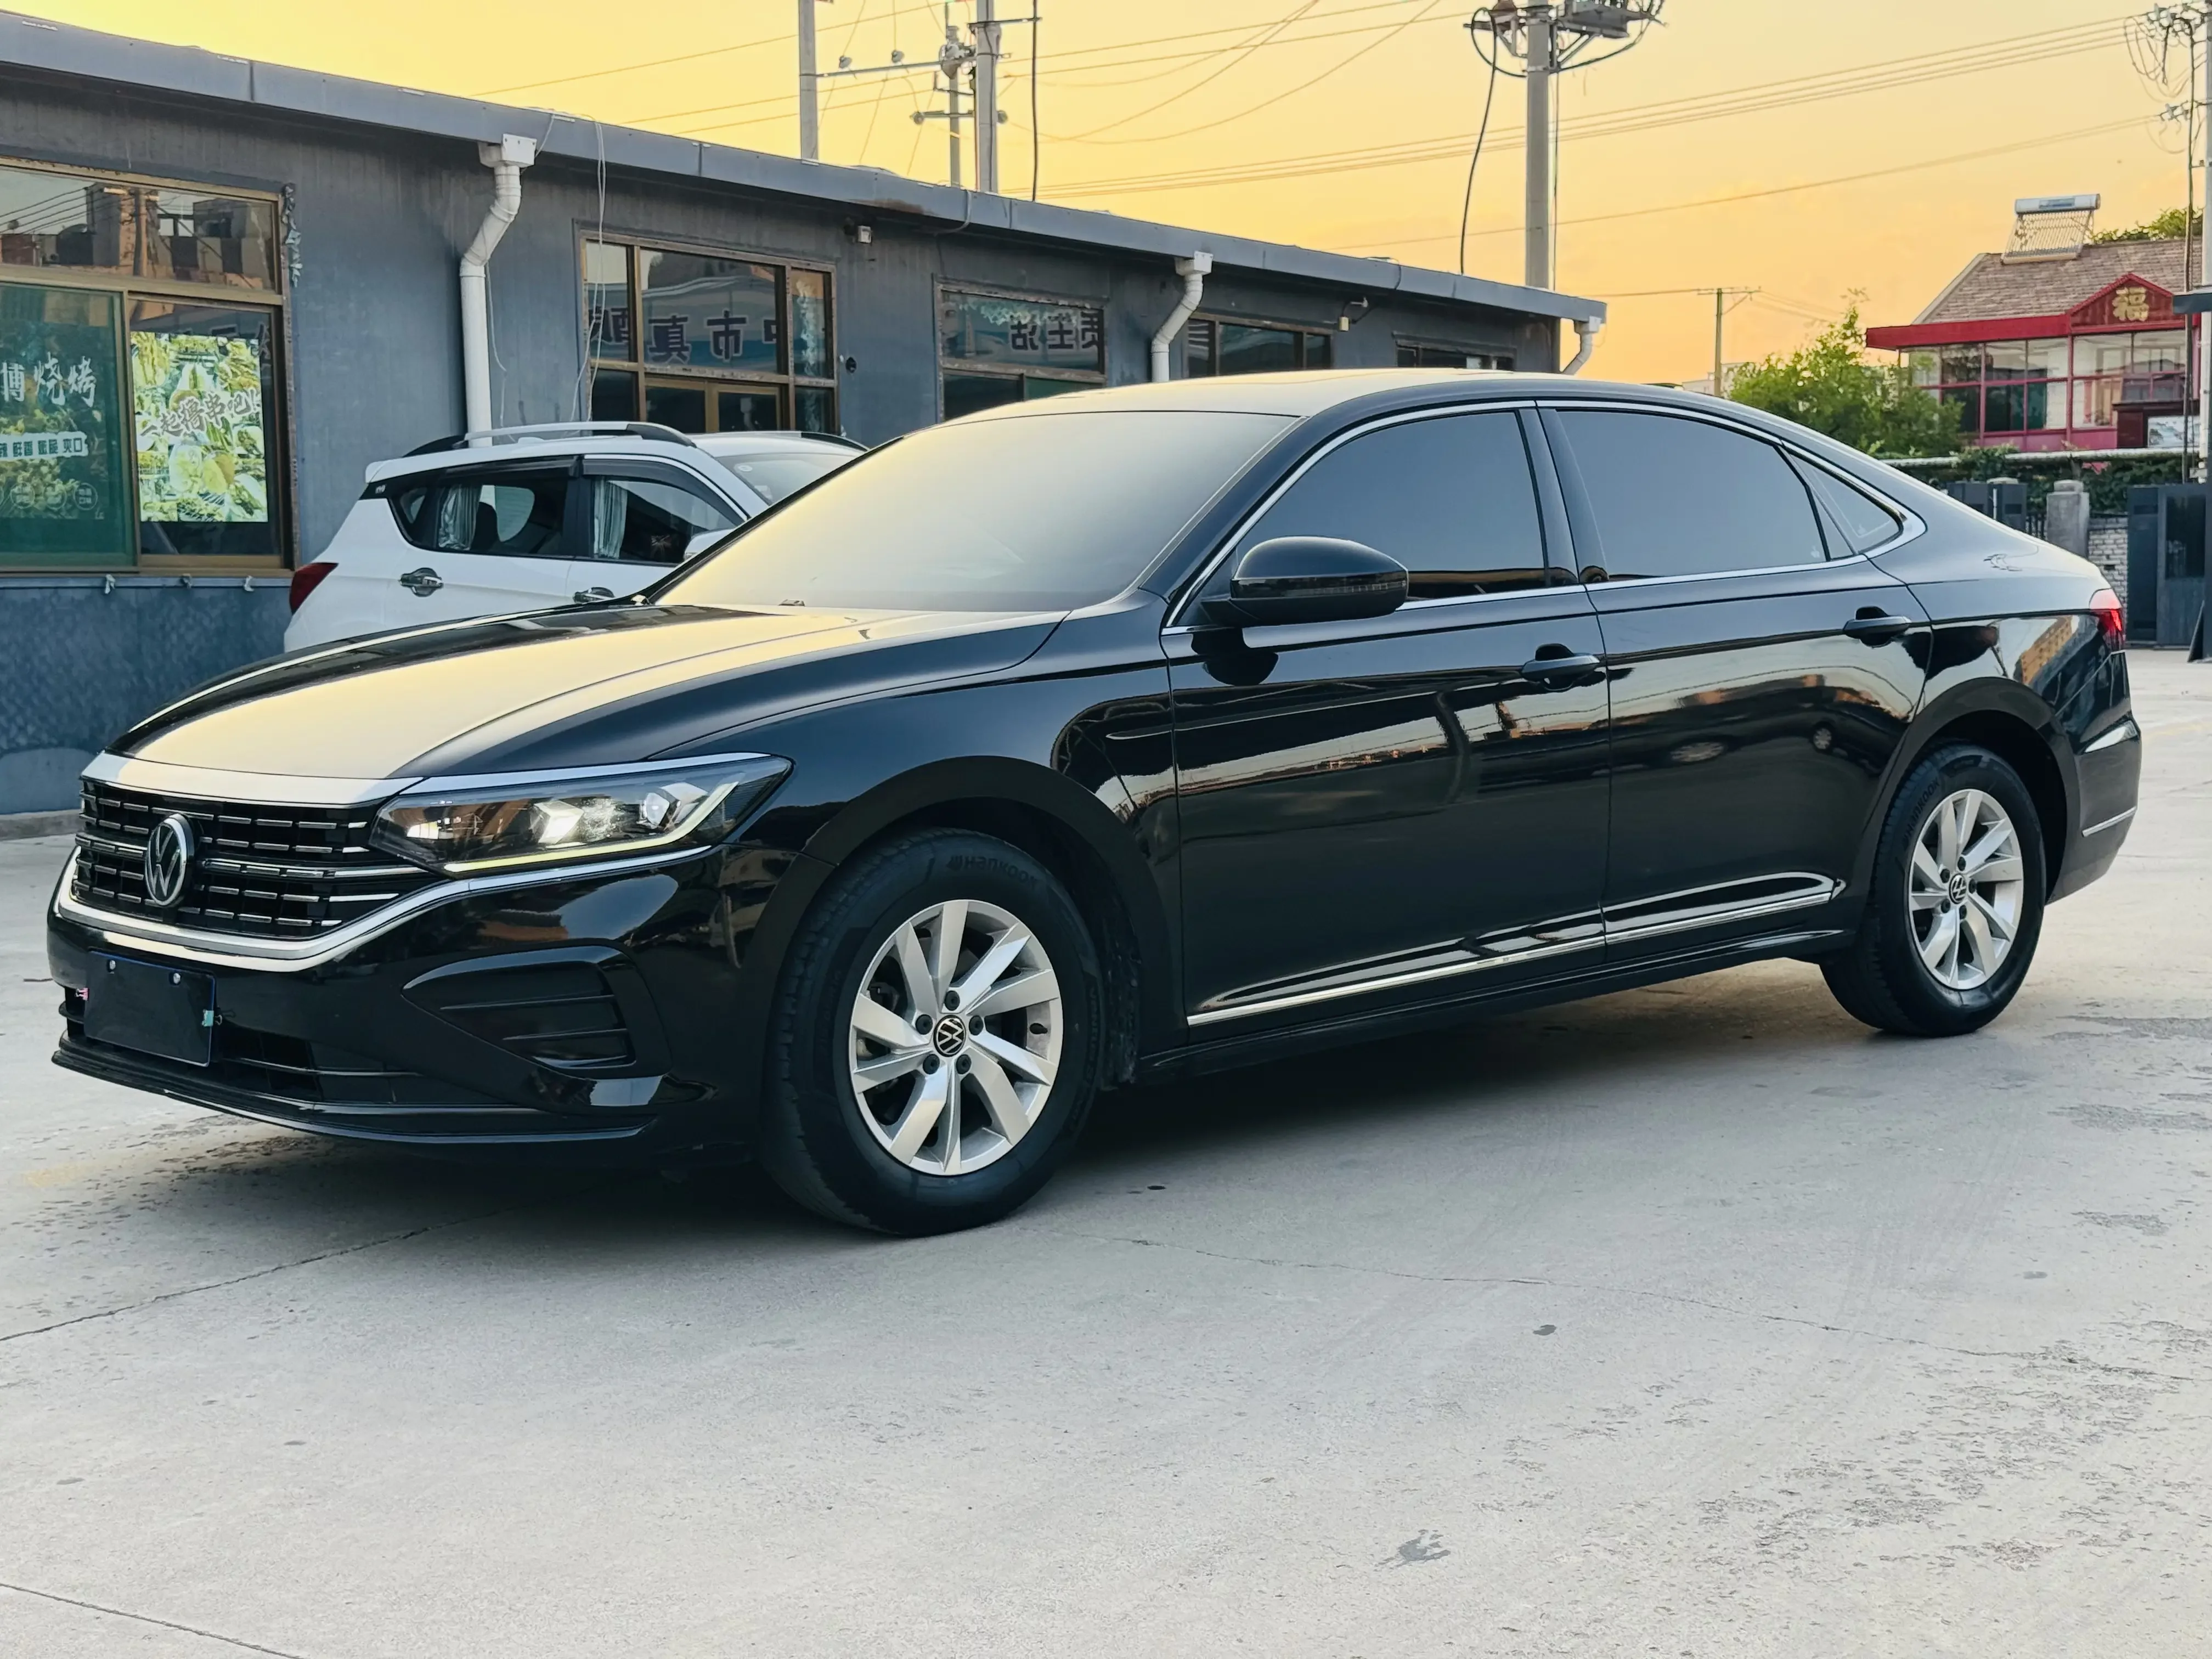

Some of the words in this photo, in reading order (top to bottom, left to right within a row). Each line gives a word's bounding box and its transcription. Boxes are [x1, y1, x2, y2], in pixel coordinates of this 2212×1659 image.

[2112, 287, 2149, 322] 福
[1, 351, 98, 408] 博烧烤
